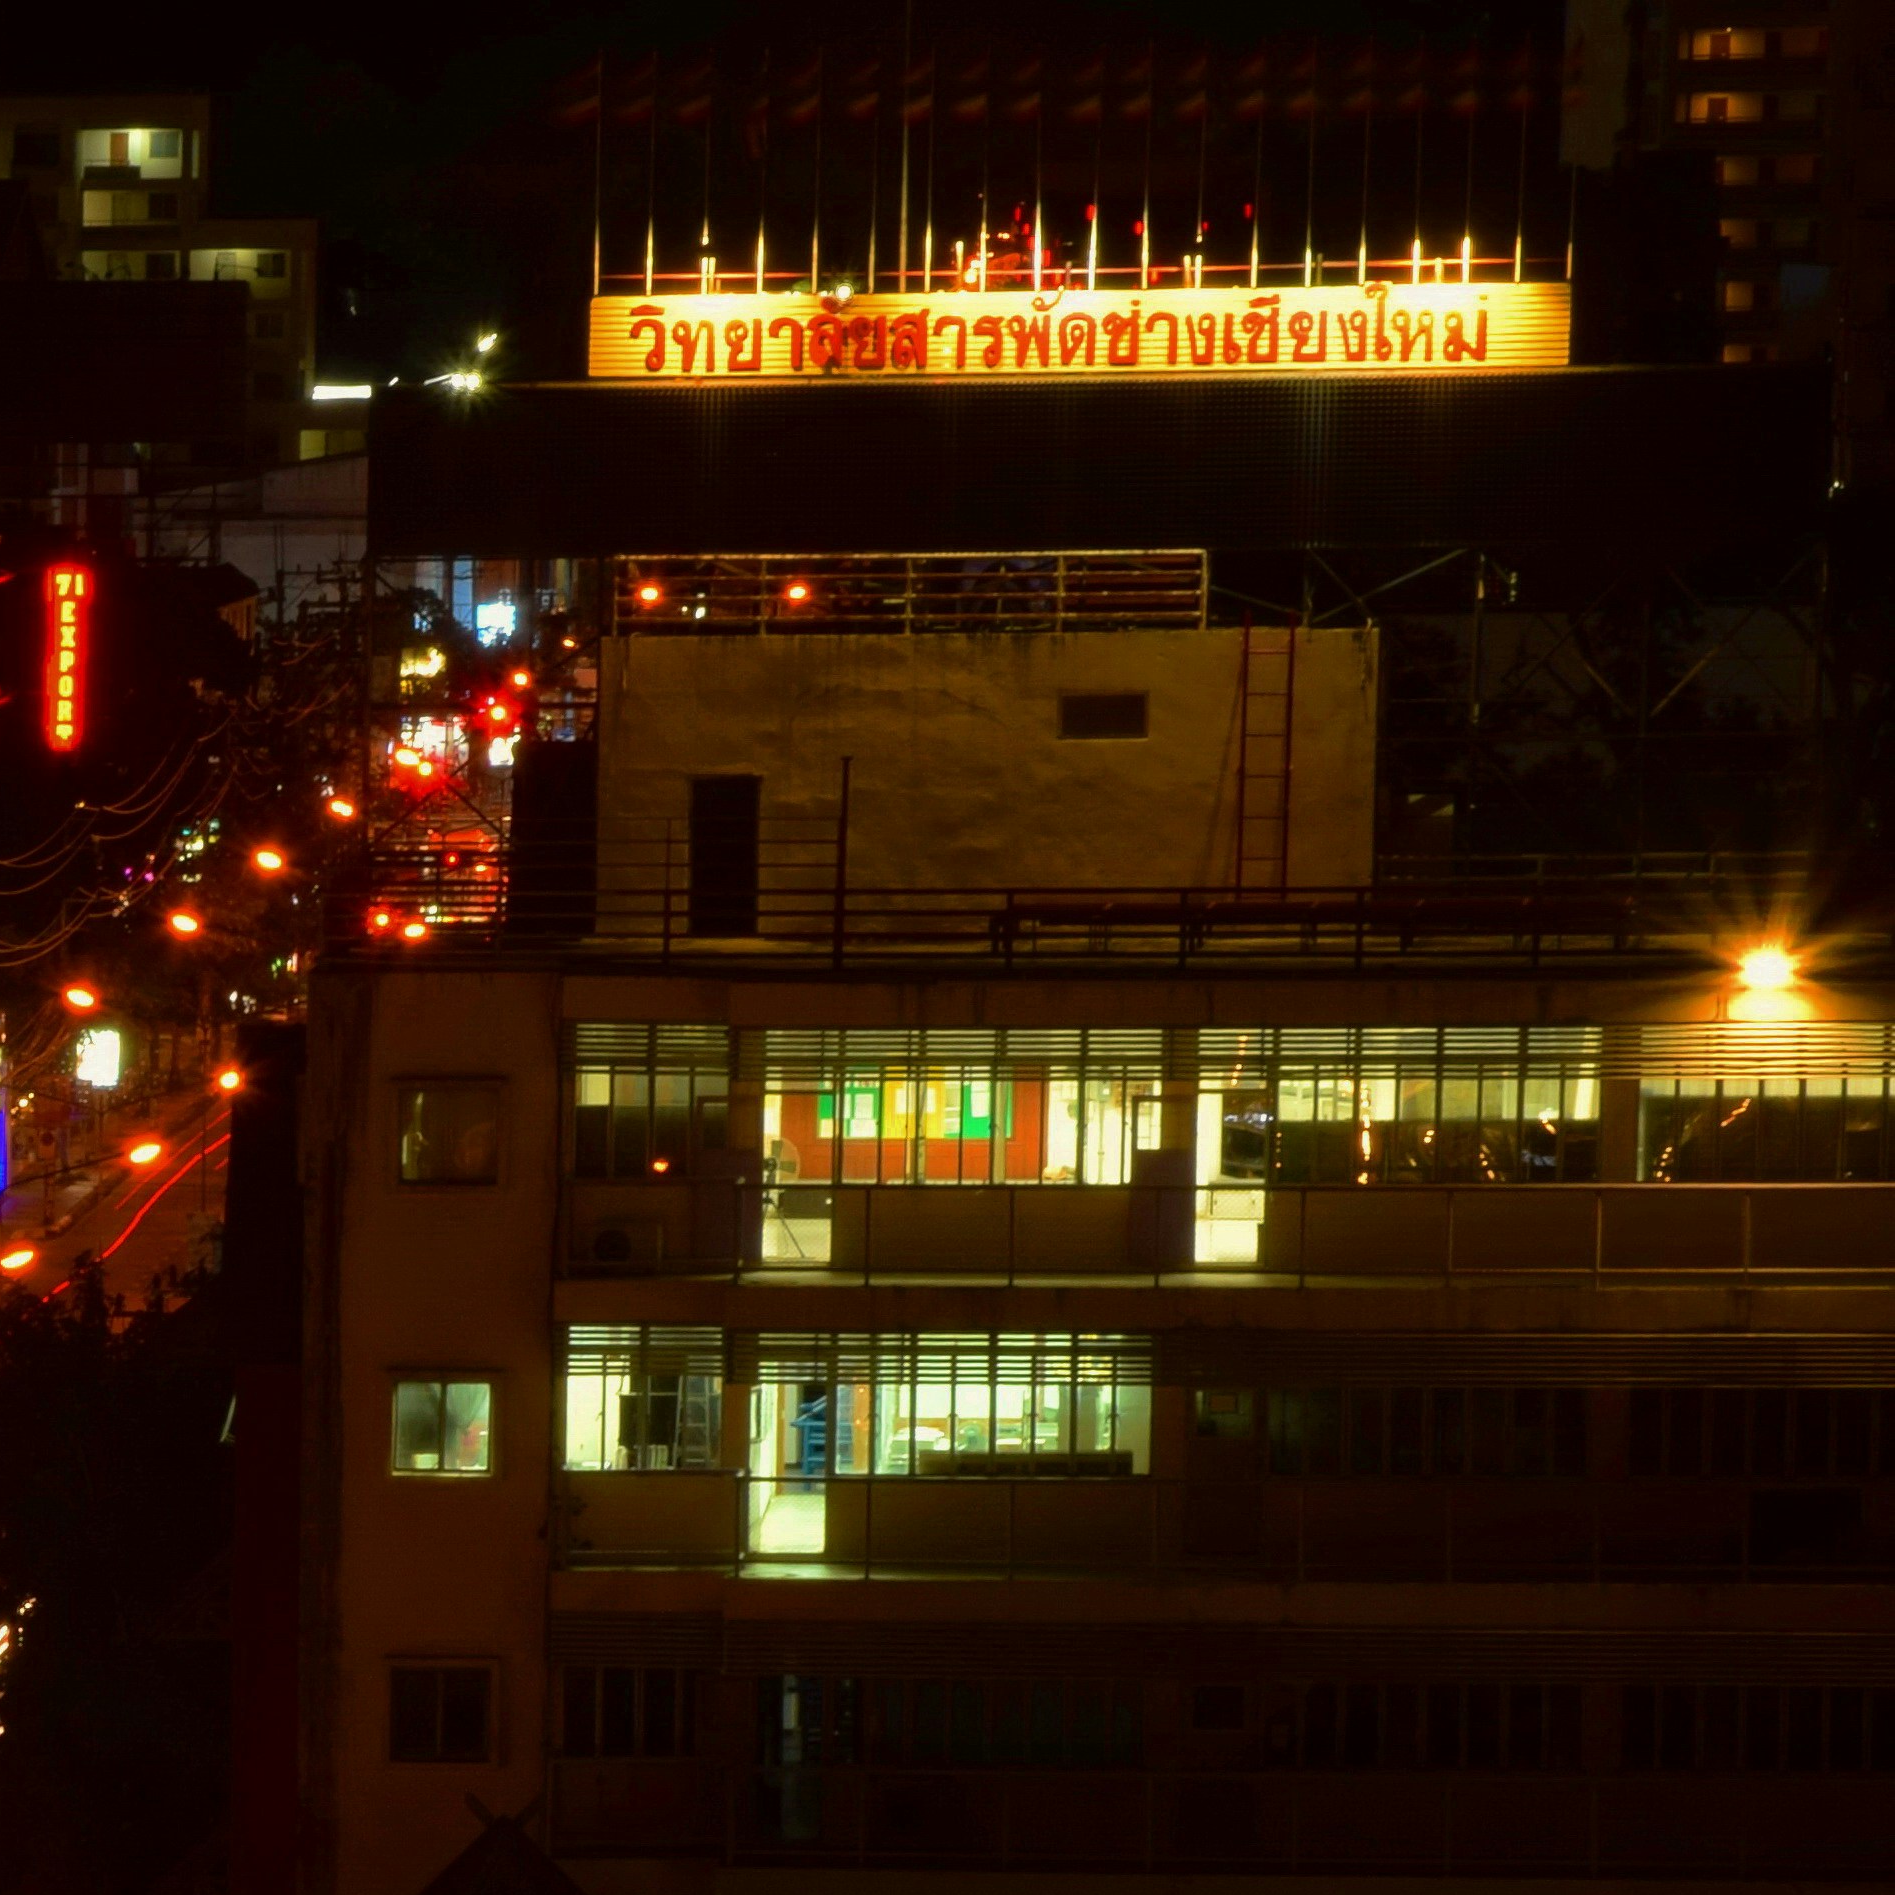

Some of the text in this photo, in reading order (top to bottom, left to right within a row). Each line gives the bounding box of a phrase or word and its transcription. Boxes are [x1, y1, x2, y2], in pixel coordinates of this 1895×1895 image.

[629, 284, 1490, 374] วิทยาลัยสารพัดช่างเชียงใหม่
